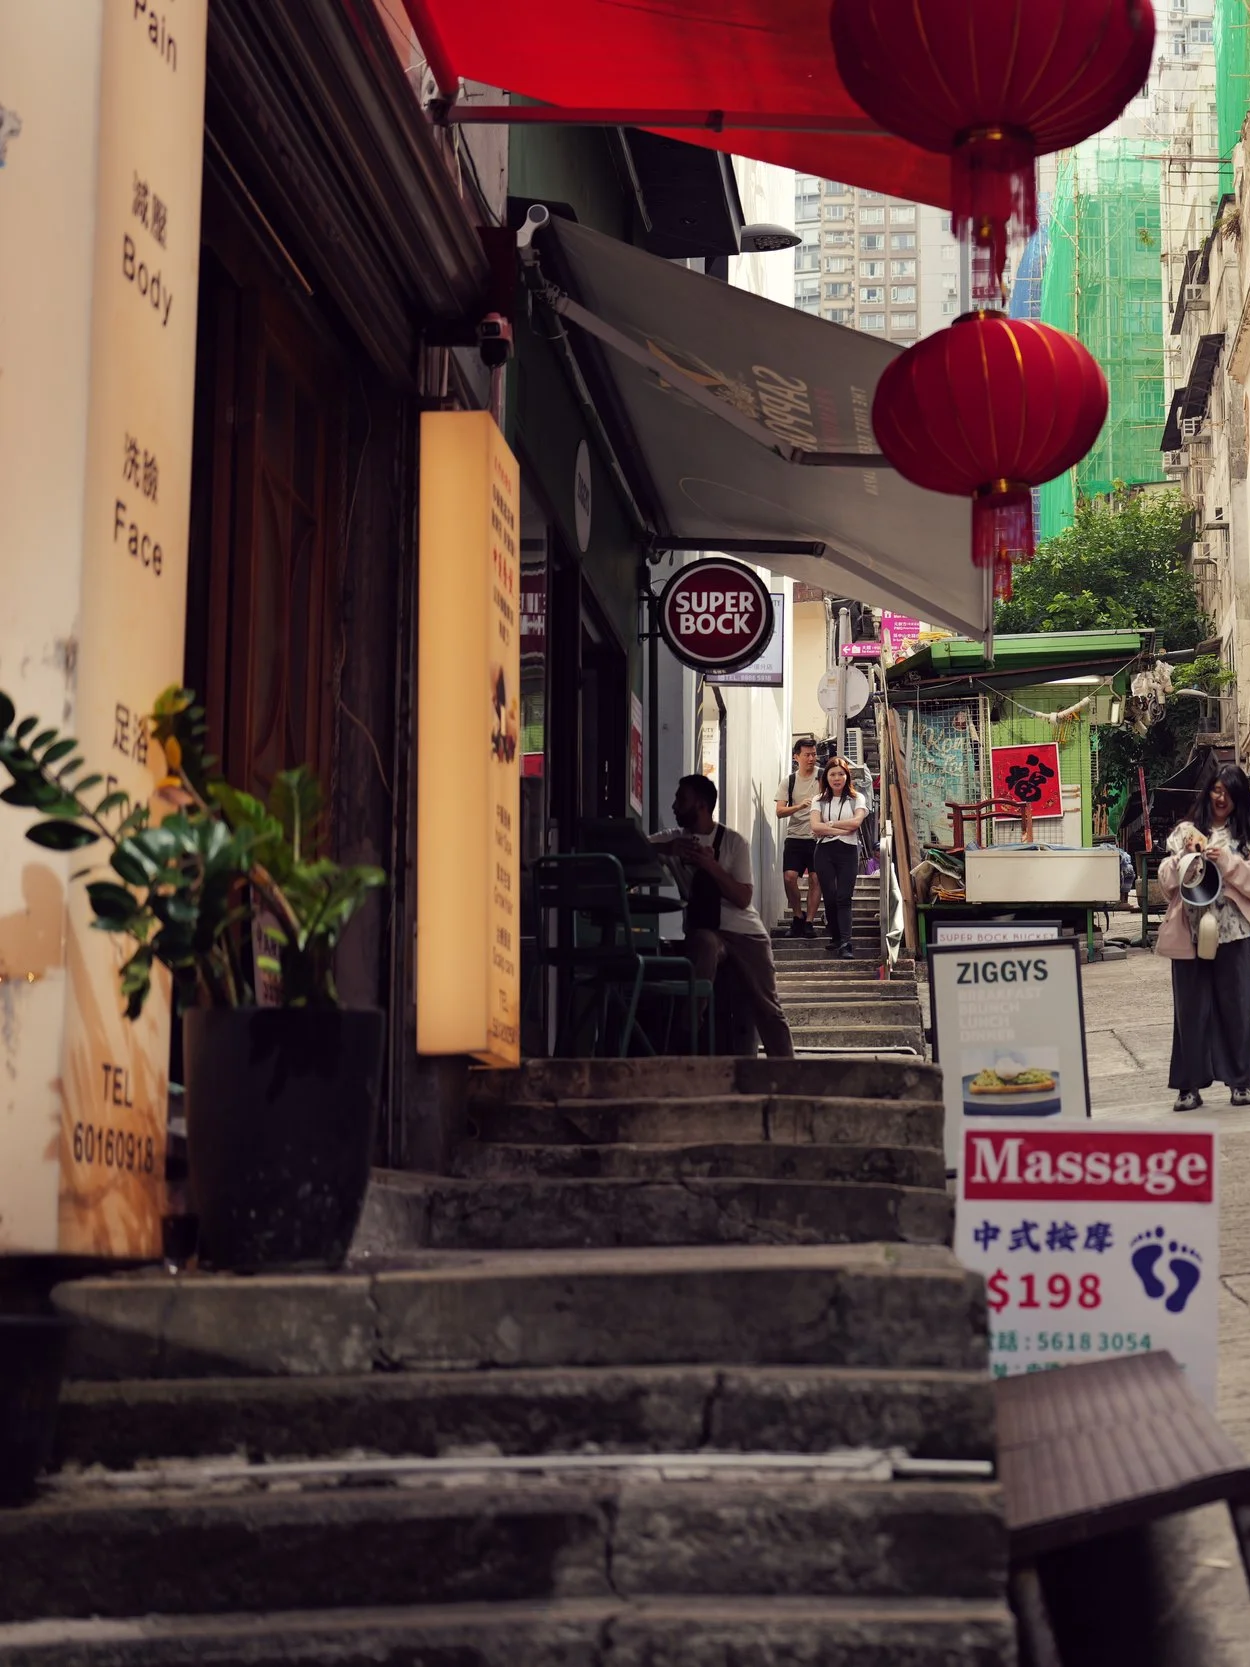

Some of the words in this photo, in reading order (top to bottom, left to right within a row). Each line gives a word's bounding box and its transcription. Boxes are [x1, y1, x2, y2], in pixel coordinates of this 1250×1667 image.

[123, 232, 172, 328] Body
[114, 498, 162, 577] Face
[675, 591, 755, 613] SUPER
[680, 613, 751, 635] BOCK
[113, 702, 149, 767] 足浴
[1005, 754, 1055, 803] 福
[940, 933, 973, 942] SUPER
[977, 933, 1009, 942] BOCK
[1013, 932, 1056, 941] BUCKET
[956, 958, 1049, 985] ZIGGYS
[957, 987, 1044, 1002] BREAKFAST
[958, 1001, 1020, 1015] BRUNCH
[959, 1015, 1010, 1029] LUNCH
[959, 1029, 1016, 1042] DINNER
[102, 1063, 133, 1108] TEL
[73, 1121, 155, 1174] 60160918
[970, 1137, 1208, 1196] Massage
[973, 1219, 1114, 1254] 中式按摩
[987, 1267, 1102, 1315] $198
[1037, 1332, 1092, 1350] 5618
[1099, 1332, 1152, 1350] 3054
